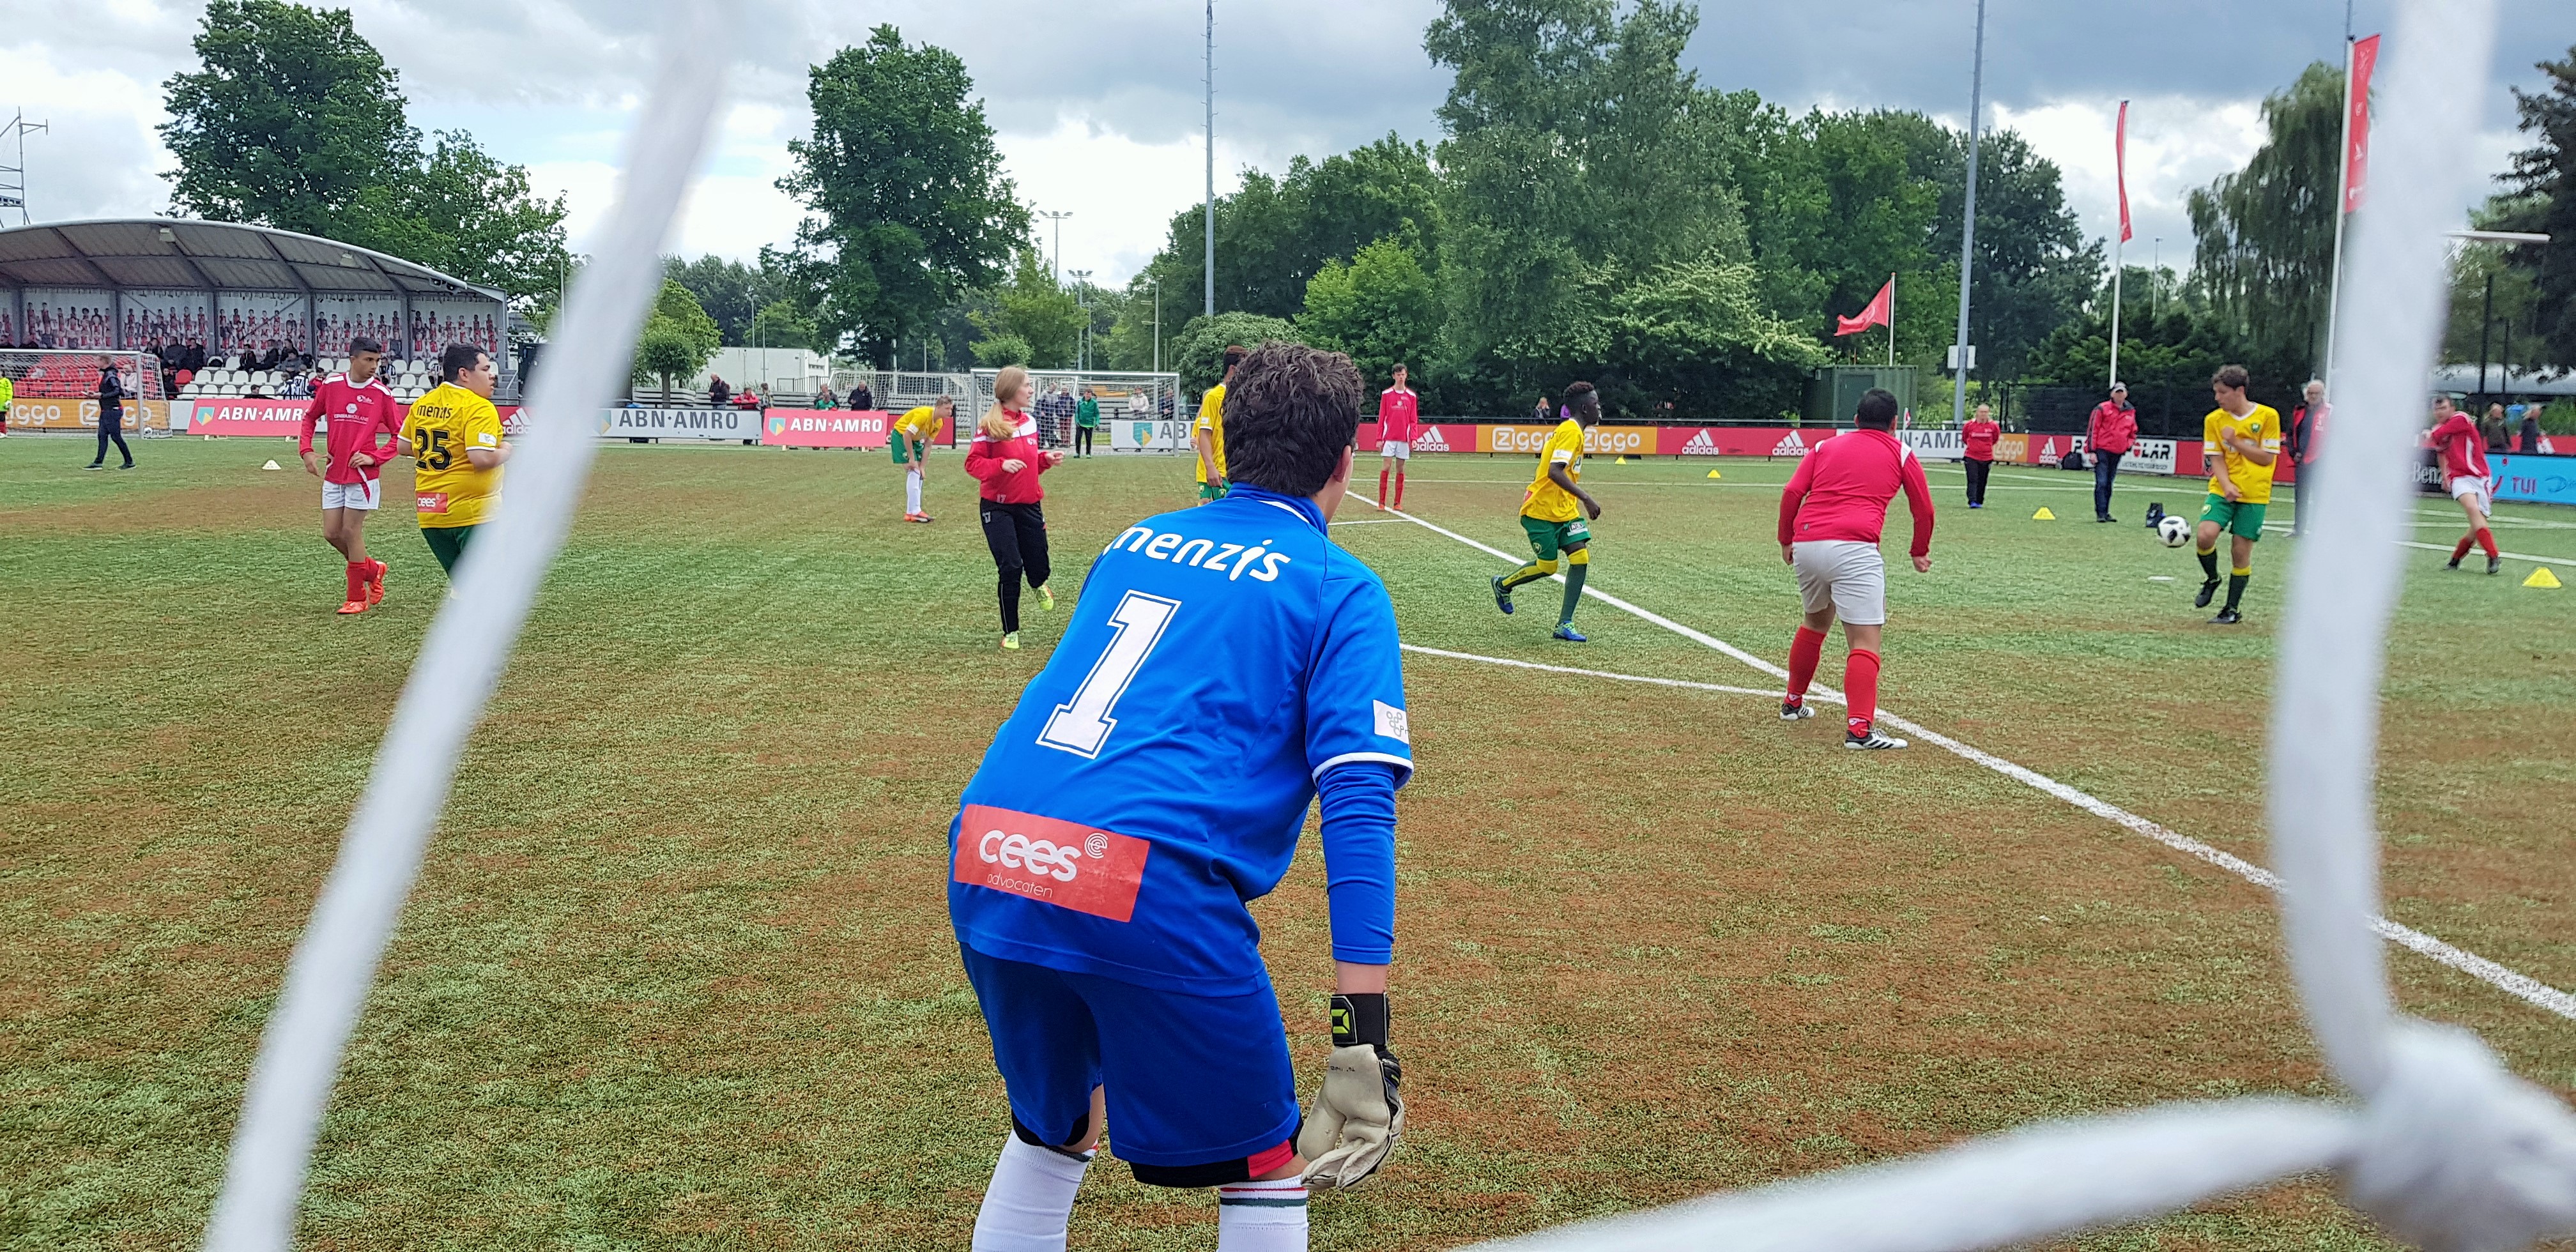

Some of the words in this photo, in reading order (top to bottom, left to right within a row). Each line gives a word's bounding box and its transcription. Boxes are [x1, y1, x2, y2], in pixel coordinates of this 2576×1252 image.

[218, 407, 307, 422] ABN·AMR
[415, 427, 453, 471] 25
[1682, 445, 1719, 455] adidas
[2511, 477, 2536, 494] TUI
[417, 497, 436, 508] cees
[1103, 526, 1291, 582] menzis
[1035, 589, 1182, 760] 1
[979, 829, 1082, 882] cees
[987, 872, 1054, 898] advocaten
